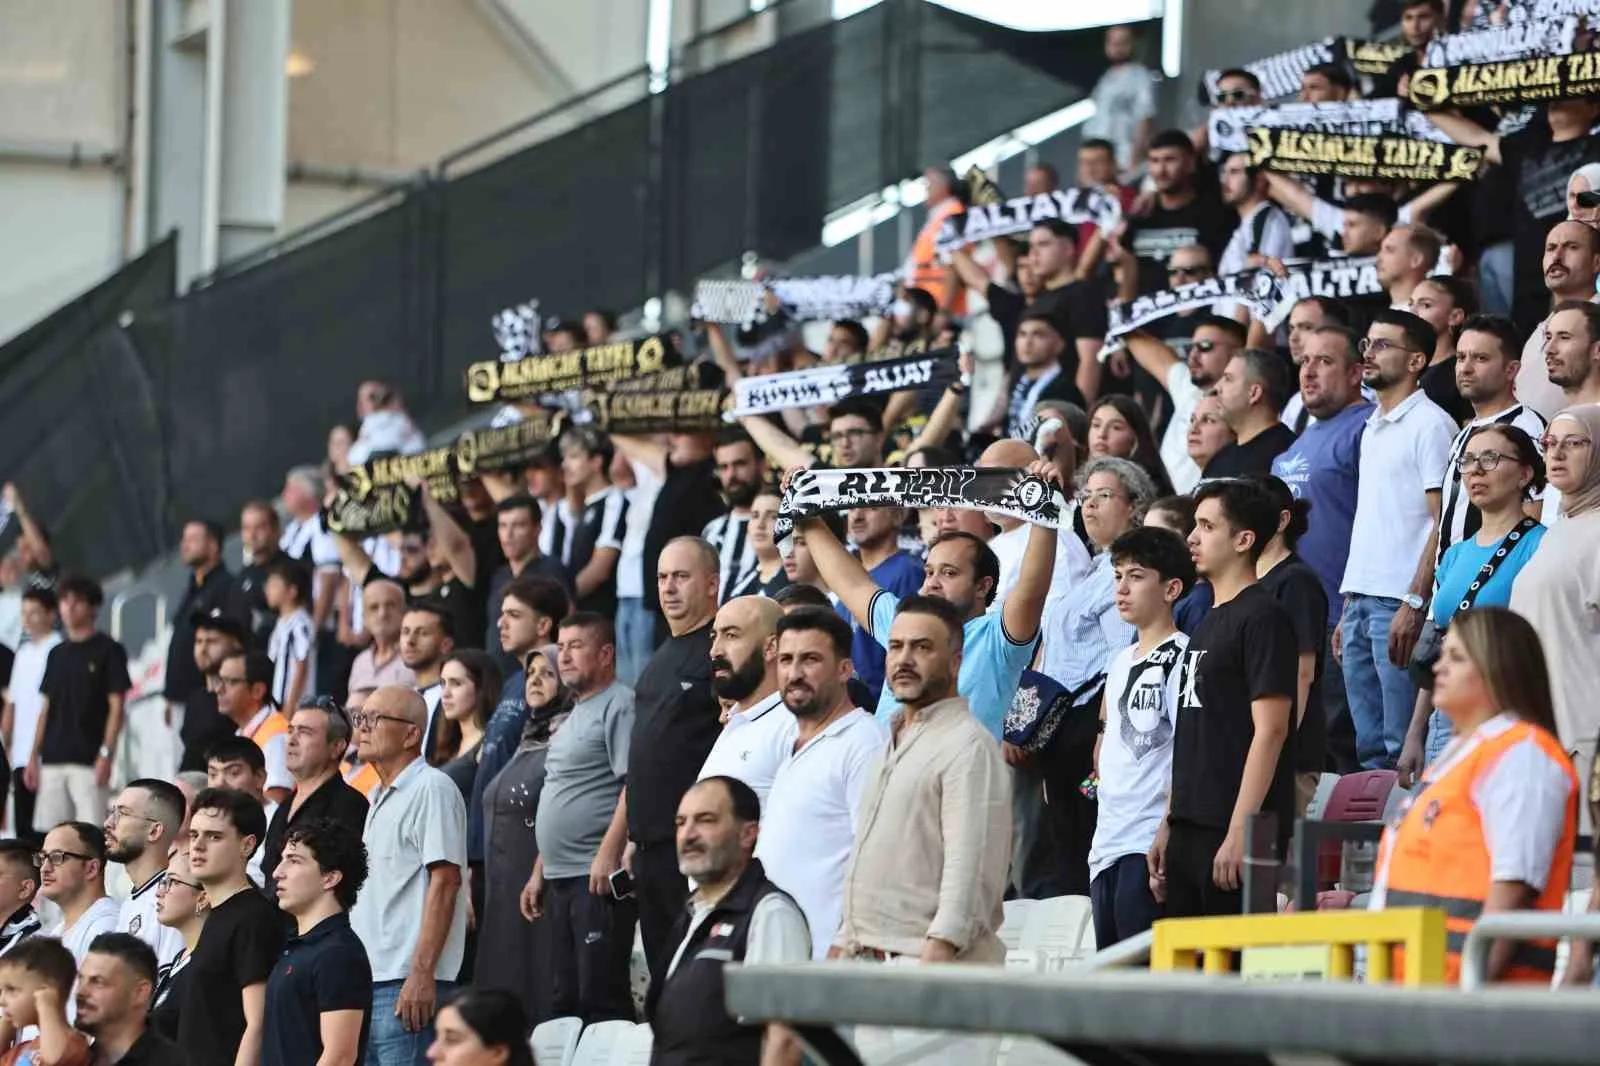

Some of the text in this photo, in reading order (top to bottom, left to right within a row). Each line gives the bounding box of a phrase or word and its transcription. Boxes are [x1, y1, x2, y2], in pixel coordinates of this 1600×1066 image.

[1452, 56, 1563, 94] ALSANCAK
[1275, 129, 1444, 167] ALSANCAK TAYFA
[963, 187, 1080, 235] ALTAY
[1289, 264, 1383, 299] ALTA
[861, 358, 933, 394] ALTAY
[838, 468, 977, 498] ALTAY
